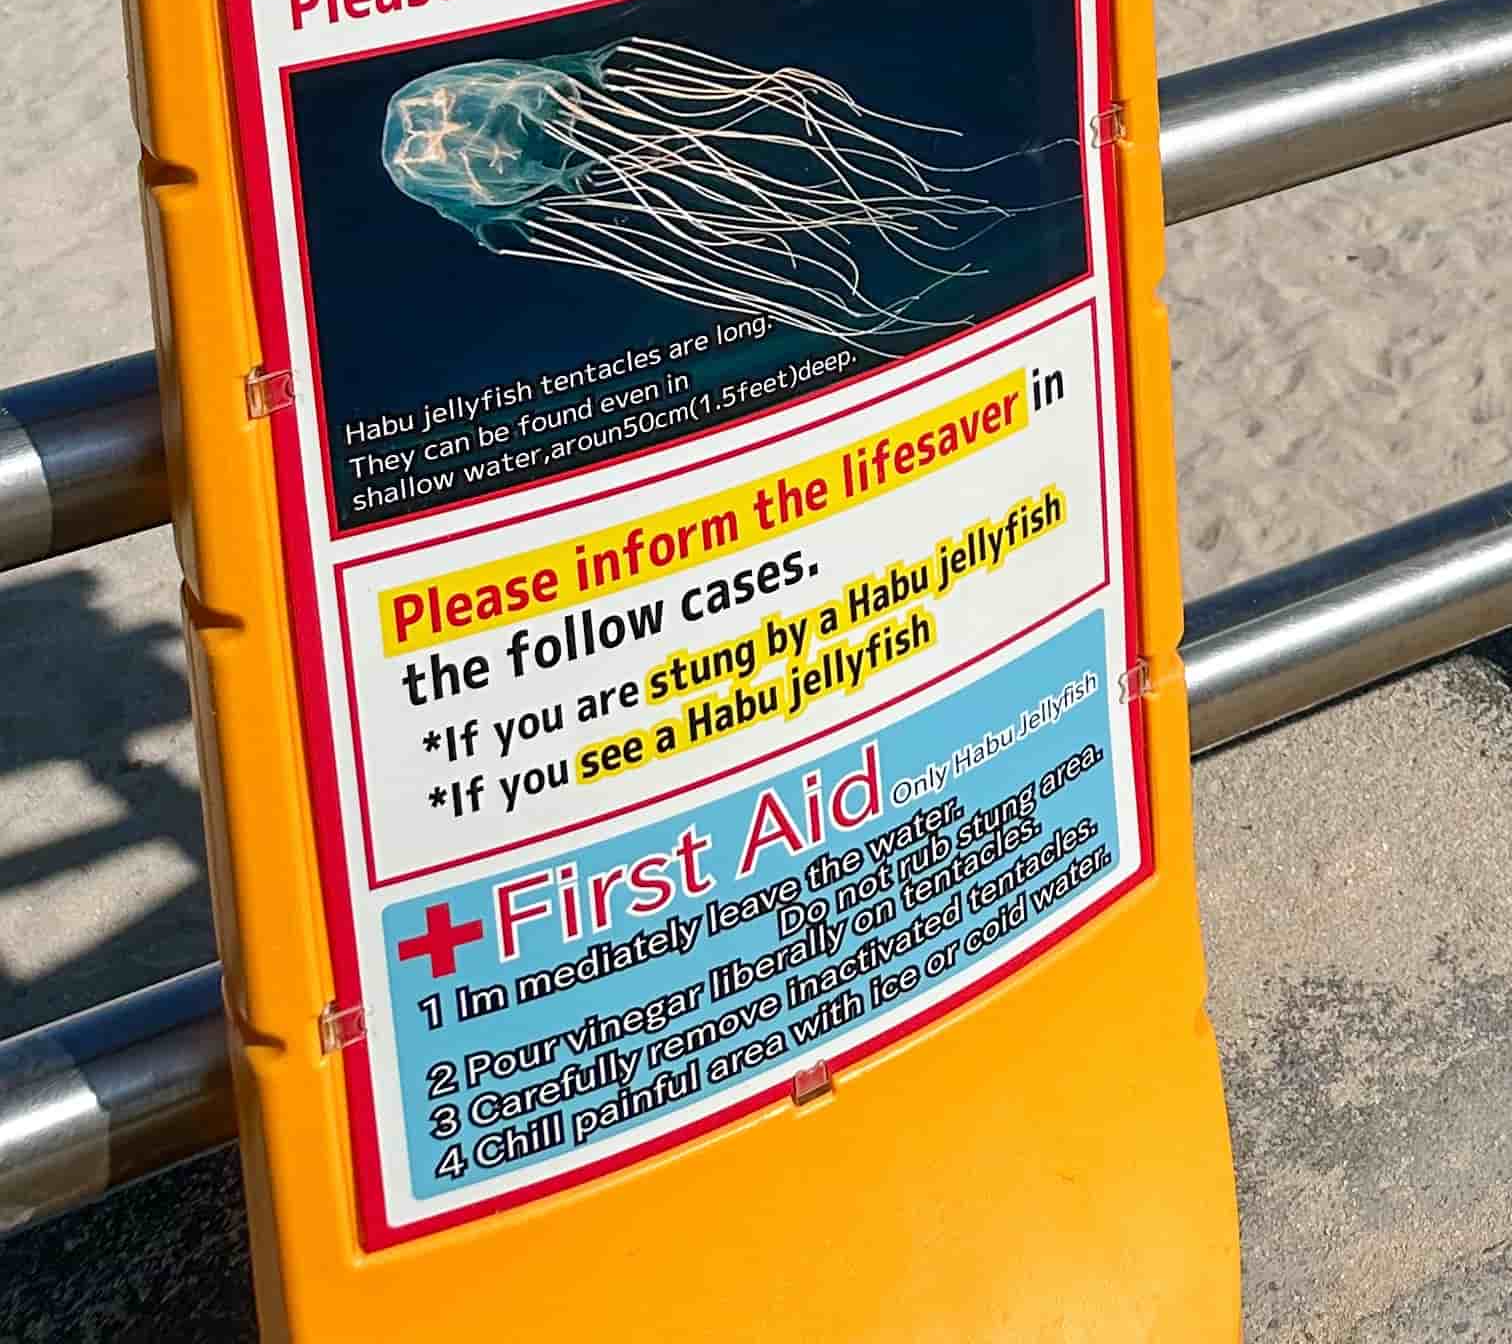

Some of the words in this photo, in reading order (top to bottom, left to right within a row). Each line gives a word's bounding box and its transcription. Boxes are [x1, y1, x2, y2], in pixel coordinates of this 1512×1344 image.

[345, 413, 415, 445] Habu
[422, 381, 532, 433] jellyfish
[539, 345, 661, 394] tentacles
[669, 336, 708, 360] are
[715, 314, 773, 345] long.
[350, 448, 415, 479] They
[423, 435, 470, 460] can
[479, 423, 510, 448] be
[517, 398, 592, 438] found
[600, 385, 658, 413] even
[667, 373, 689, 393] in
[353, 474, 454, 511] shallow
[391, 561, 559, 643] Please
[575, 504, 739, 592] inform
[754, 474, 829, 532] the
[842, 388, 1022, 500] lifesaver
[1031, 365, 1065, 411] in
[403, 645, 490, 706] the
[506, 594, 664, 678] follow
[679, 544, 820, 623] cases.
[493, 701, 564, 757] you
[575, 679, 639, 722] are
[648, 632, 757, 700] stung
[767, 611, 808, 663] by
[820, 605, 838, 634] a
[848, 566, 929, 622] Habu
[937, 492, 1063, 593] jellyfish
[499, 756, 571, 813] you
[578, 734, 644, 782] see
[657, 721, 675, 751] a
[688, 680, 778, 743] Habu
[789, 616, 931, 715] jellyfish
[420, 993, 442, 1030] 1
[457, 983, 504, 1022] Im
[516, 915, 699, 1002] mediately
[707, 874, 800, 929] leave
[807, 847, 861, 892] the
[868, 796, 965, 862] water.
[493, 822, 713, 963] First
[736, 739, 883, 880] Aid
[892, 762, 948, 806] Only
[953, 728, 1013, 775] Habu
[1019, 673, 1098, 740] Jellyfish
[776, 898, 826, 939] Do
[838, 868, 890, 908] not
[899, 837, 950, 881] rub
[957, 796, 1036, 847] stung
[1039, 742, 1104, 798] area.
[428, 1061, 458, 1099] 2
[464, 1035, 559, 1086] Pour
[565, 976, 703, 1054] vinegar
[711, 919, 847, 996] liberally
[852, 898, 894, 935] on
[901, 820, 1043, 907] tentacles.
[430, 1106, 459, 1139] 3
[469, 1044, 640, 1124] Carefully
[646, 993, 782, 1069] remove
[786, 900, 962, 1003] inactivated
[968, 817, 1099, 909] tentacles.
[434, 1144, 467, 1181] 4
[472, 1108, 565, 1166] Chill
[573, 1063, 699, 1145] painful
[706, 1028, 788, 1082] area
[792, 990, 863, 1046] with
[871, 969, 918, 1008] ice
[925, 942, 959, 977] or
[965, 898, 1027, 954] cold
[1028, 845, 1112, 909] water.
